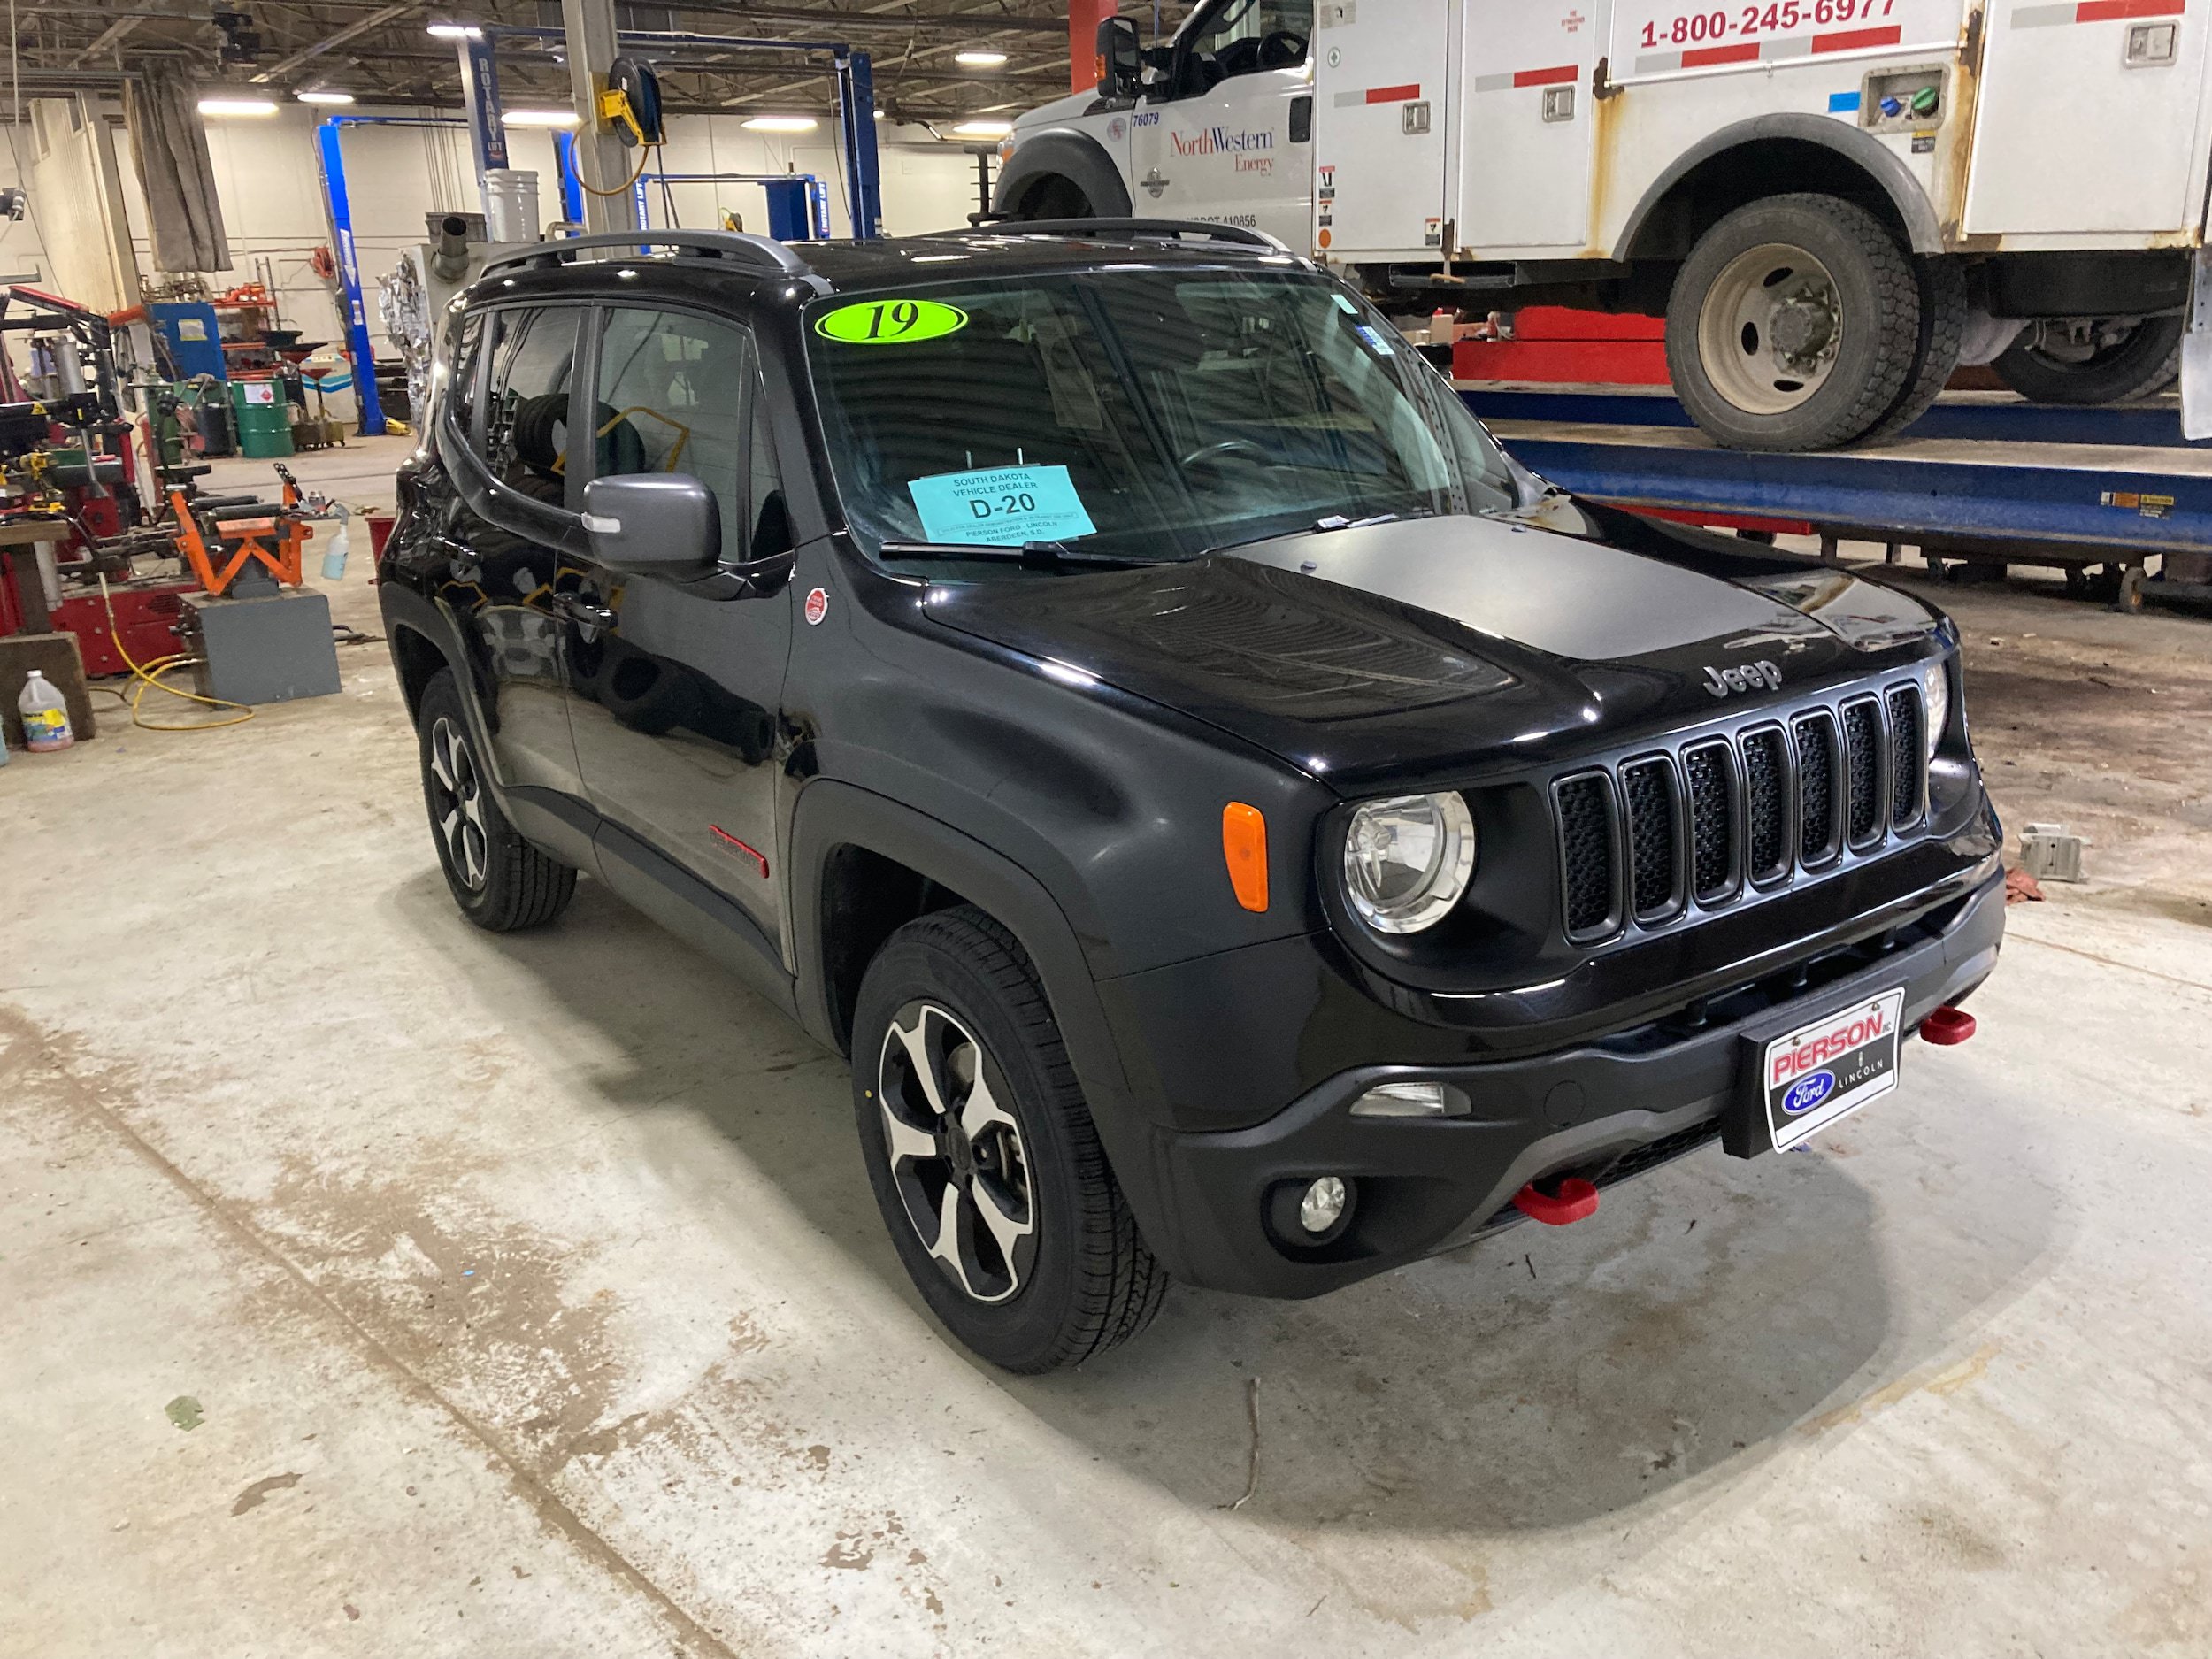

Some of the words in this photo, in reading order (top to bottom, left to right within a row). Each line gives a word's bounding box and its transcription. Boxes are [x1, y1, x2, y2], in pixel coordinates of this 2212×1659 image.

[478, 58, 497, 142] ROTARY
[1133, 111, 1159, 127] 76079
[1170, 126, 1274, 157] NorthWestern
[1235, 154, 1274, 177] Energy
[638, 200, 647, 230] ROTARY
[862, 302, 919, 340] 19
[953, 484, 996, 496] VEHICLE
[998, 482, 1038, 492] DEALER
[954, 475, 988, 487] SOUTH
[991, 472, 1031, 483] DAKOTA
[969, 493, 1035, 518] D-20
[966, 528, 998, 537] PIERSON
[1000, 525, 1021, 534] FORD
[1703, 660, 1783, 699] Jeep
[1773, 1010, 1884, 1086] PIERSON
[1839, 1058, 1884, 1089] LINCOLN
[1793, 1077, 1825, 1108] Ford
